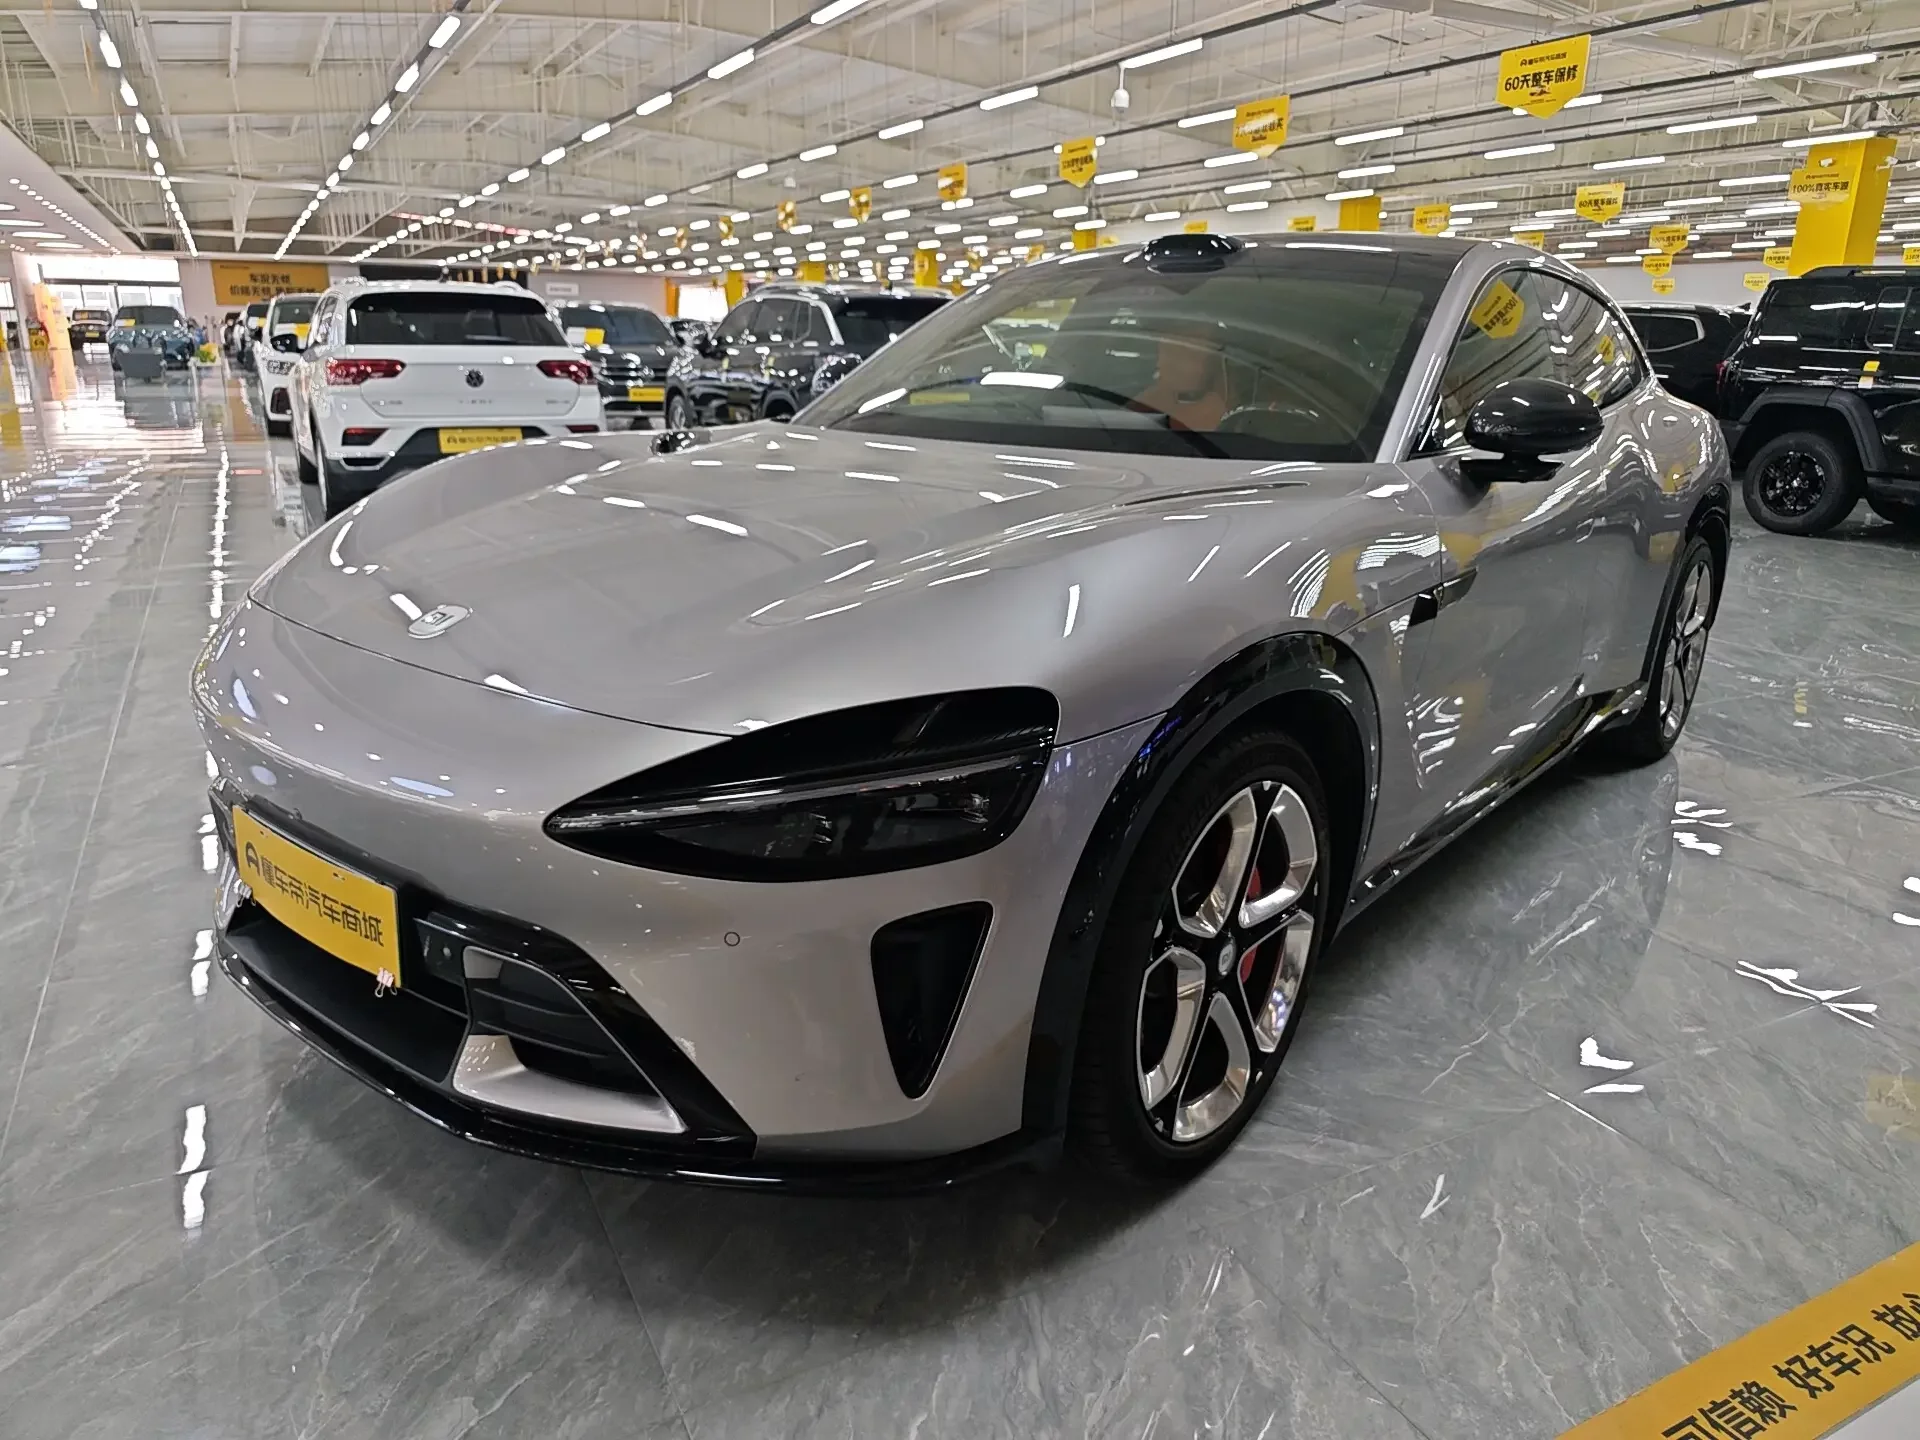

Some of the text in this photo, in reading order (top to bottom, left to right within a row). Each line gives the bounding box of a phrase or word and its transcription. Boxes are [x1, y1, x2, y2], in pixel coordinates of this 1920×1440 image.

[1504, 64, 1578, 92] 60天整车保修
[261, 854, 385, 948] 懂车帝汽车商城
[1771, 1323, 1896, 1399] 好车况
